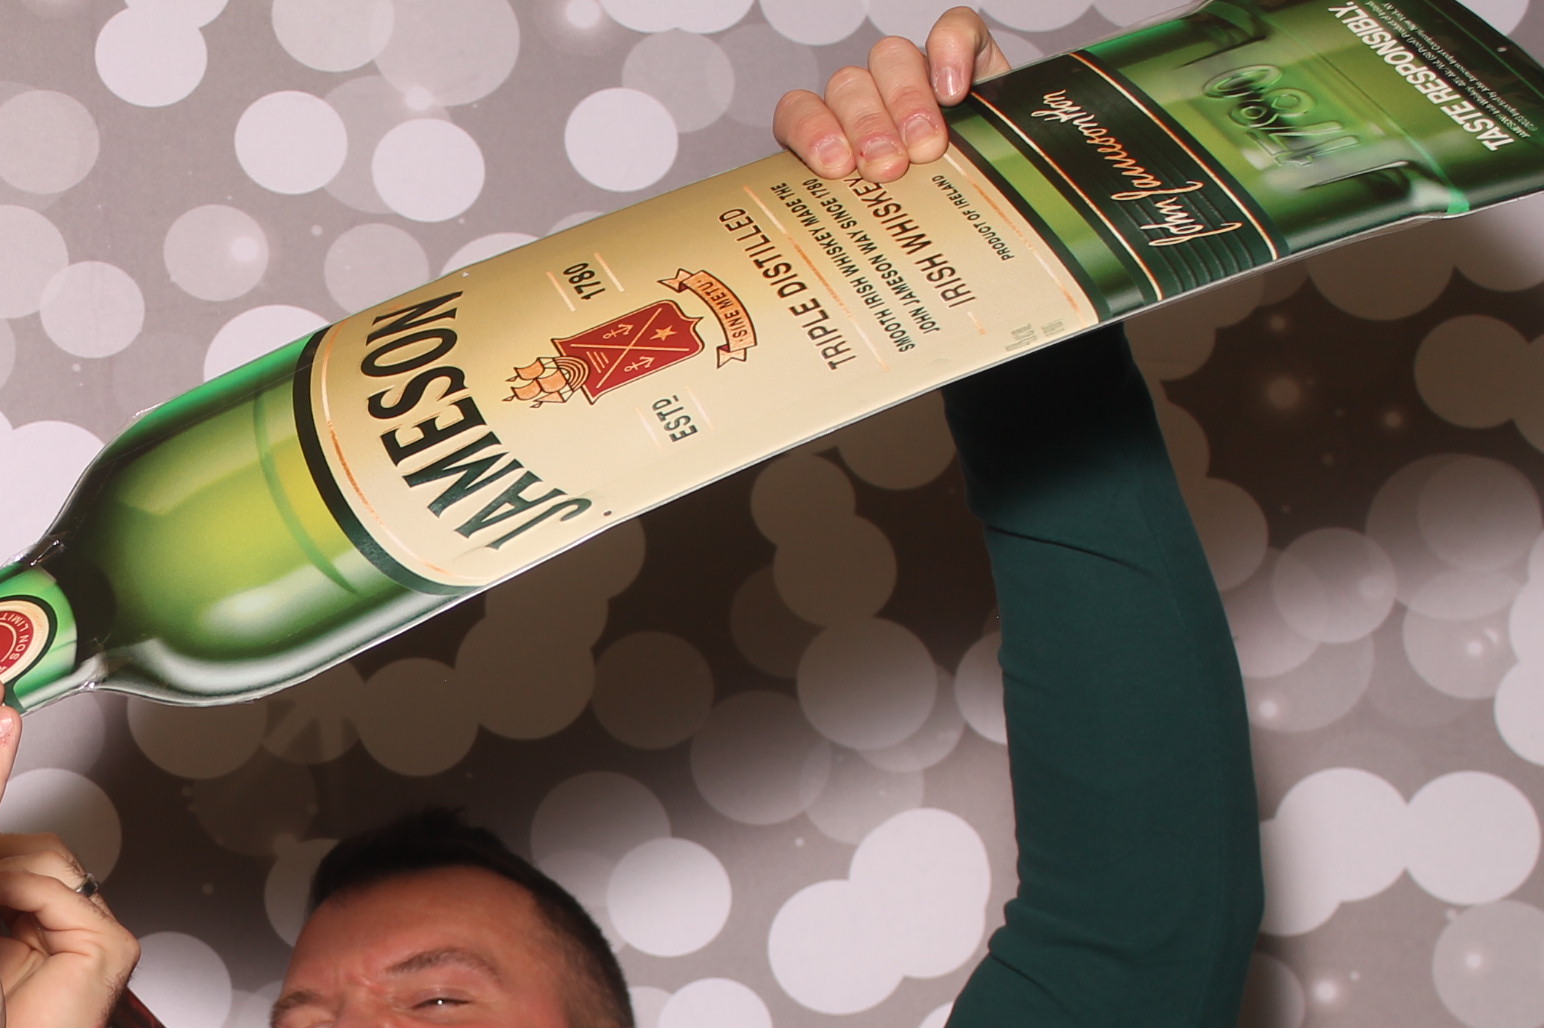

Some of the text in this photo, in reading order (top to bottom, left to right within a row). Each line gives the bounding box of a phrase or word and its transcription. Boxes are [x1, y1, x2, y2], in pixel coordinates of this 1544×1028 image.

[1203, 64, 1359, 166] 1780
[1328, 1, 1514, 151] TASTE RESPONSIBLY.
[802, 178, 941, 334] JOHN JAMESON WAY SINCE 1780
[931, 175, 1015, 261] PRODUCT OF IRELAND
[1140, 197, 1243, 247] John
[563, 262, 606, 300] 1780
[702, 280, 748, 339] SINE METU
[718, 208, 857, 370] TRIPLE DISTILLED
[770, 182, 916, 352] SMOOTH IRISH WHISKEY MADE THE
[914, 253, 976, 308] IRISH
[360, 291, 592, 550] JAMESON
[651, 395, 698, 442] ESTD
[9, 634, 29, 661] SON
